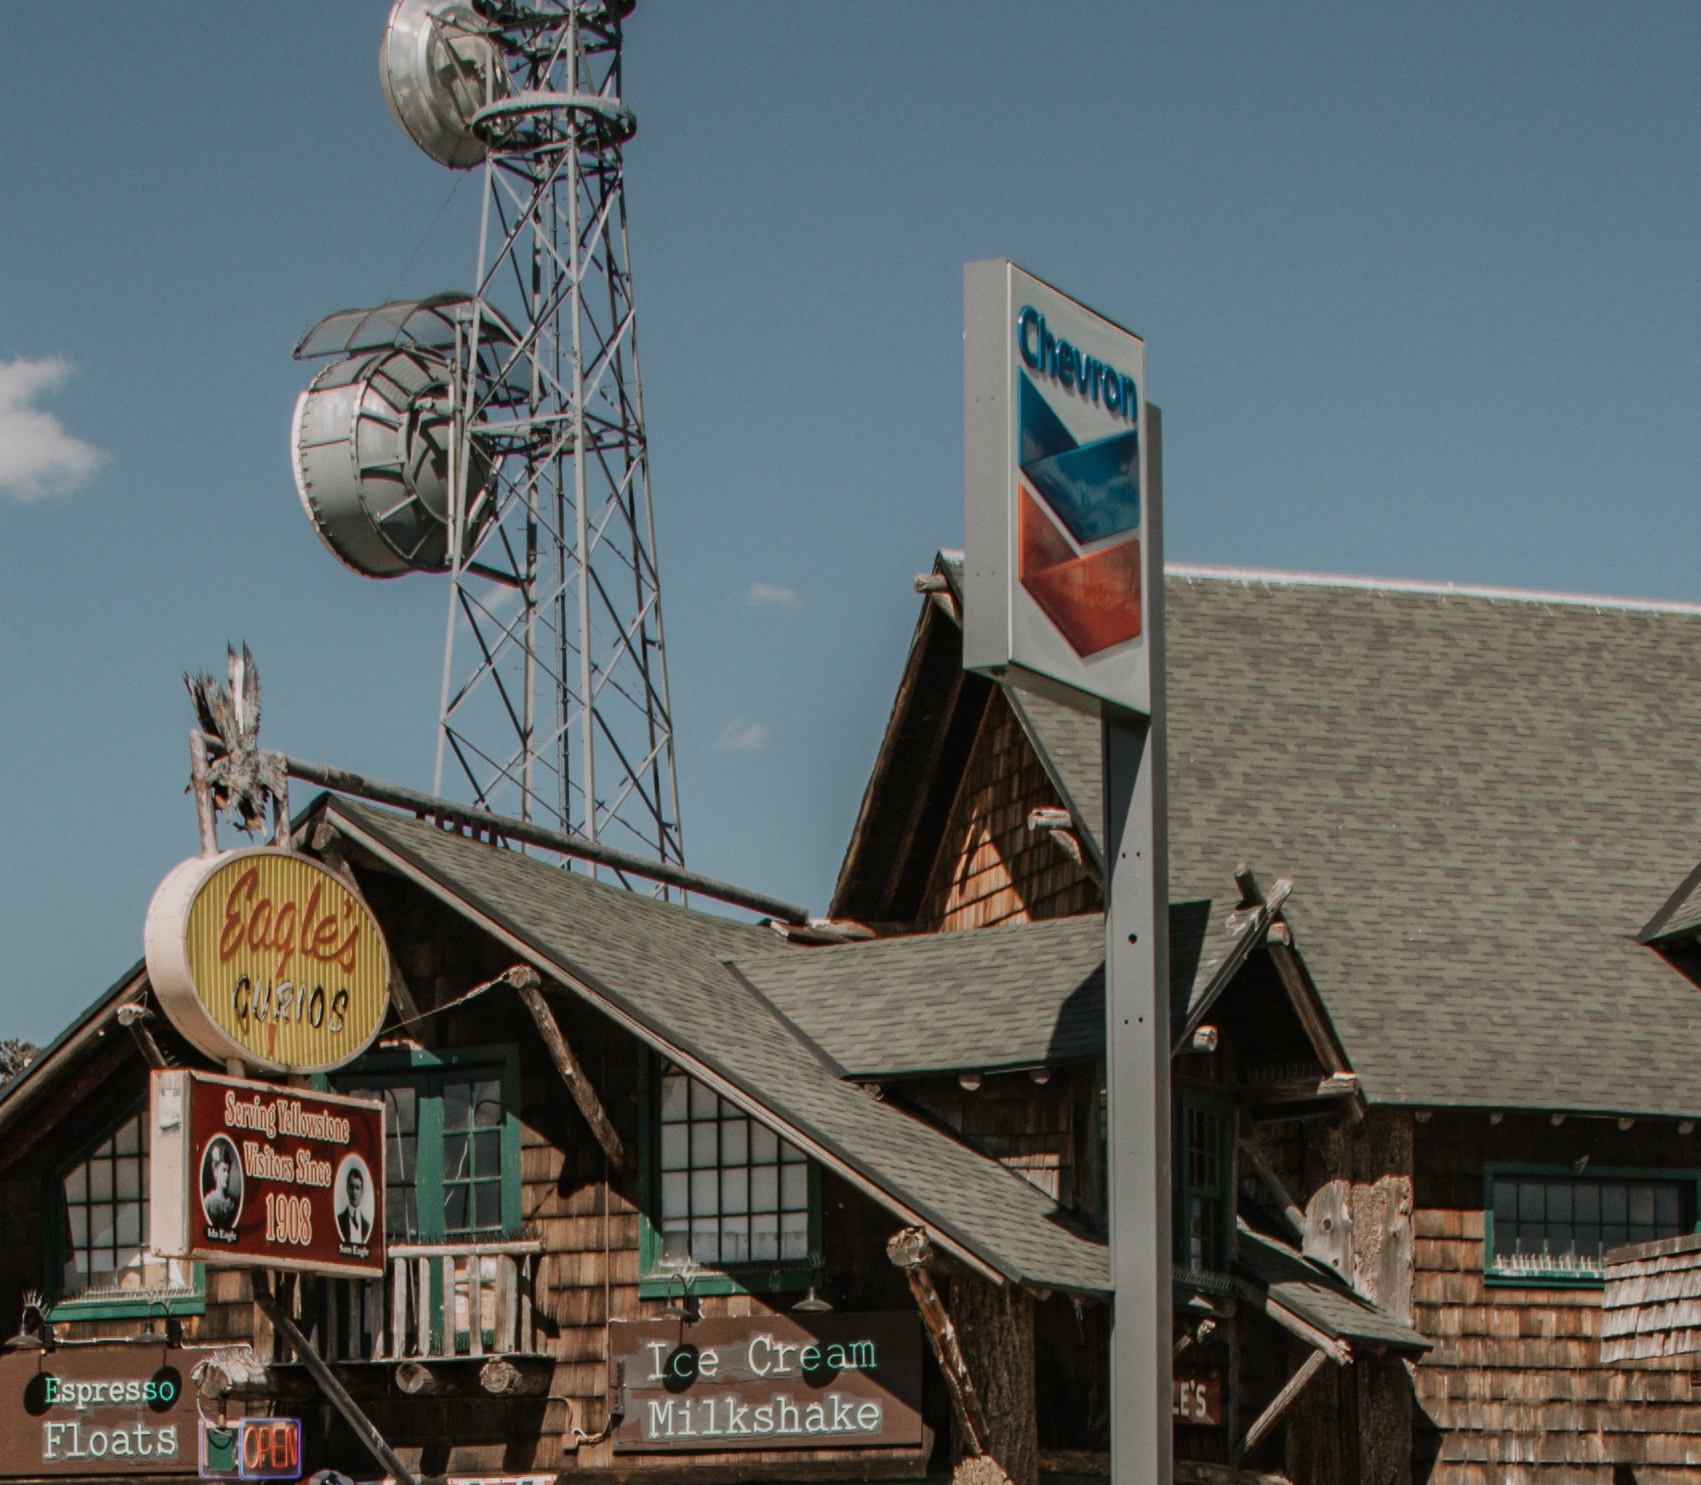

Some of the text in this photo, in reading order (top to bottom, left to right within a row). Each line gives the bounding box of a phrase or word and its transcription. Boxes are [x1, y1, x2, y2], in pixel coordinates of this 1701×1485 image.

[1017, 304, 1138, 424] Chevron
[219, 866, 360, 978] Eagle's
[233, 975, 349, 1032] CURIOS
[225, 1090, 349, 1144] Serving Yellowstone
[243, 1141, 331, 1188] Visitors Since
[265, 1192, 312, 1247] 1908
[647, 1335, 877, 1379] Ice Cream
[45, 1377, 175, 1411] Espresso
[648, 1396, 881, 1438] Milkshake
[43, 1422, 177, 1461] Floats
[243, 1426, 298, 1470] OPEN
